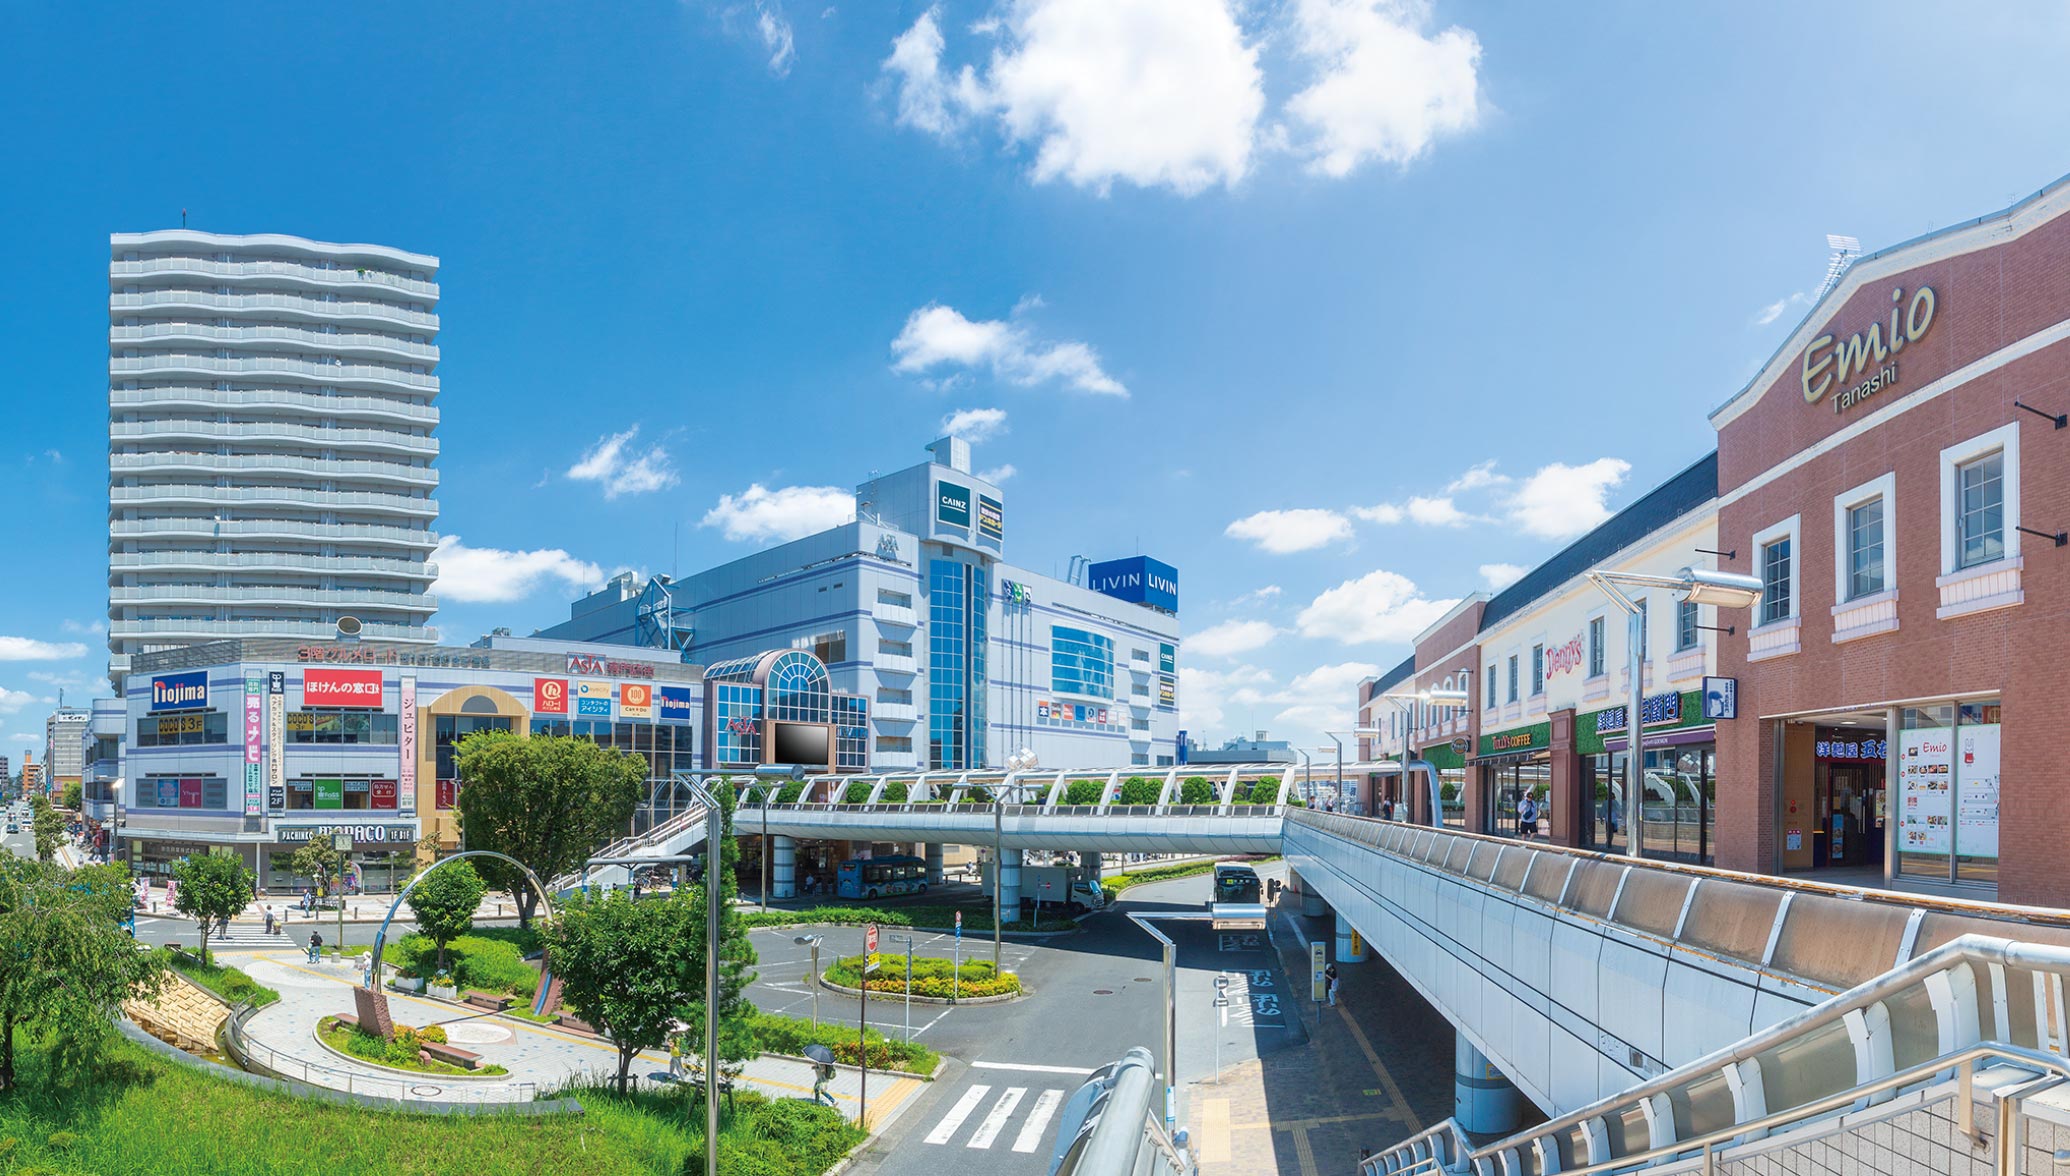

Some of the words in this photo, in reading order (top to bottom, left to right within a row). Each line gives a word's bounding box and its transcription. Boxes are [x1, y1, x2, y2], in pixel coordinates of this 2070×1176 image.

[1802, 286, 1935, 402] Emio
[1831, 361, 1896, 413] Tanashi
[942, 496, 966, 509] CAINZ
[1093, 573, 1140, 591] LIVIN
[1148, 573, 1176, 596] LIVIN
[568, 655, 603, 674] ASTA
[1546, 634, 1582, 679] Denny's
[306, 682, 375, 695] ほけんの窓口
[159, 717, 186, 732] COCO'S
[188, 717, 203, 730] 3F
[287, 714, 314, 724] COCO'S
[404, 699, 414, 759] ジュピター
[1510, 734, 1531, 746] COFFEE
[1923, 742, 1947, 753] Emio
[1816, 741, 1858, 758] 洋麺屋
[282, 831, 314, 840] PACHINKO
